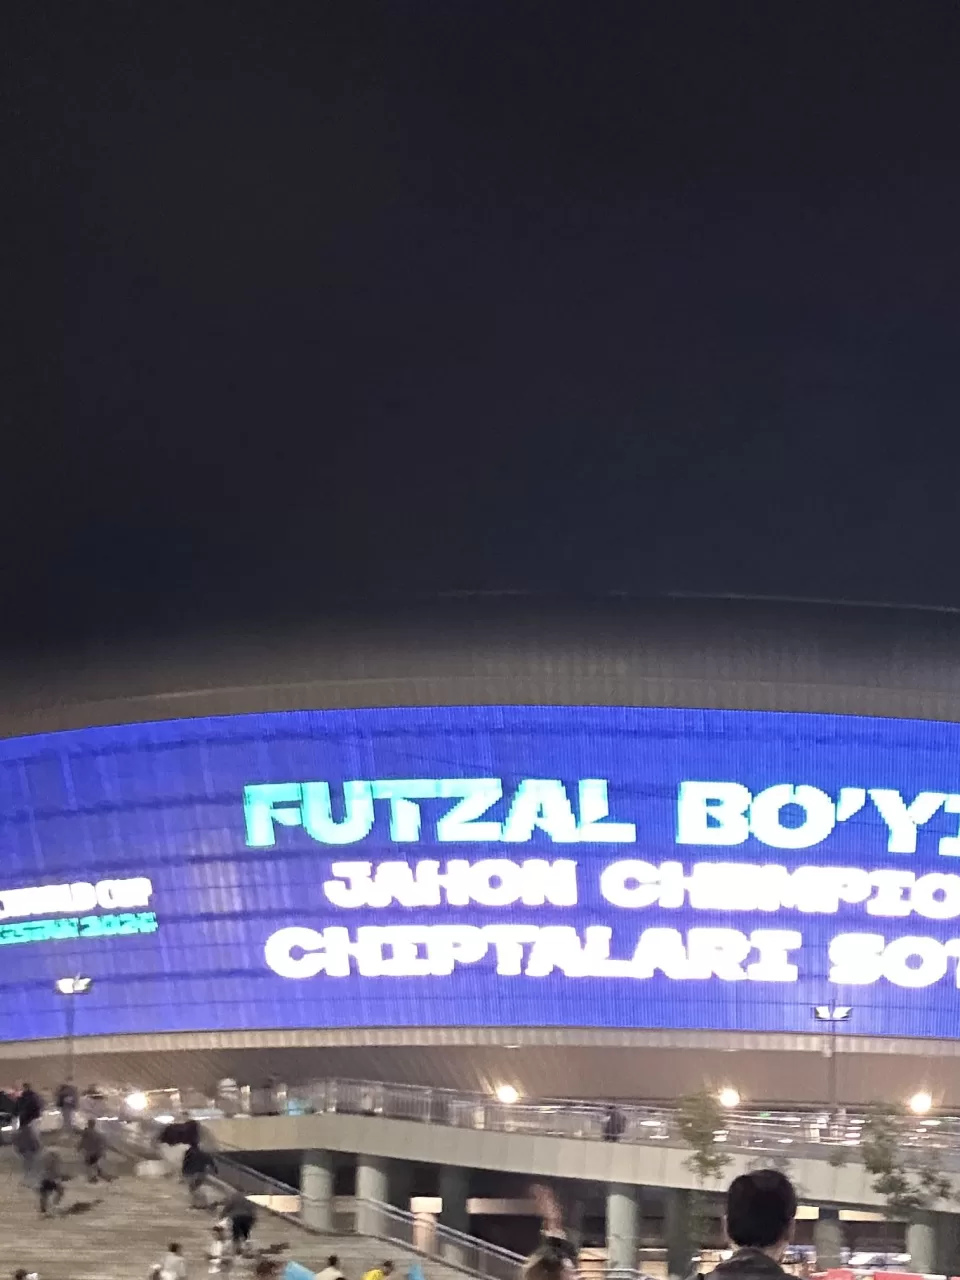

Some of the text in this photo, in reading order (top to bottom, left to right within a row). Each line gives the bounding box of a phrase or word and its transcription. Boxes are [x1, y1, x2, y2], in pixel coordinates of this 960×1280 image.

[244, 778, 636, 846] FUTZAL
[324, 859, 578, 908] JAHON
[264, 924, 802, 981] CHIPTALARI
